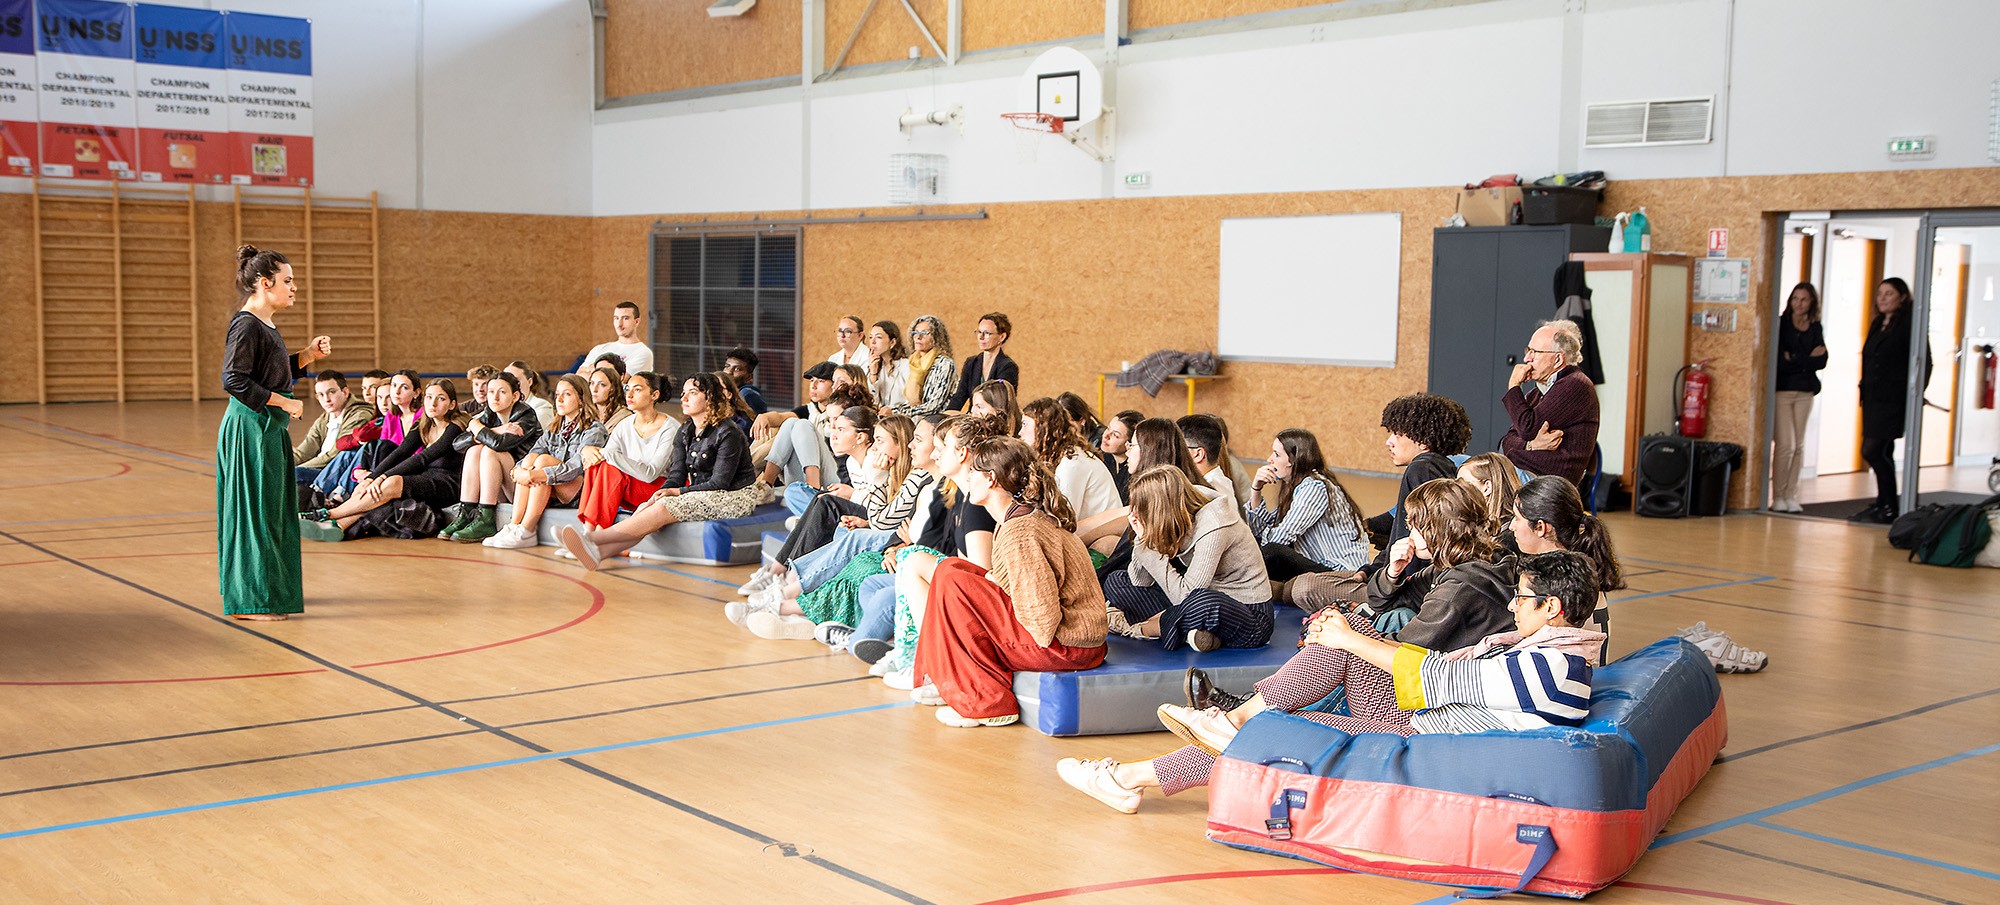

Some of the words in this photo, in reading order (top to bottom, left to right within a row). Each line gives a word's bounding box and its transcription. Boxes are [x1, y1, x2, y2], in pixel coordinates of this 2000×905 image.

[55, 72, 115, 84] CHAMPION
[150, 78, 210, 90] CHAMPION
[42, 84, 132, 98] DEPARTEMENTAL
[240, 83, 297, 95] CHAMPION
[137, 90, 227, 104] DEPARTEMENTAL
[228, 95, 312, 109] DEPARTEMENTAL
